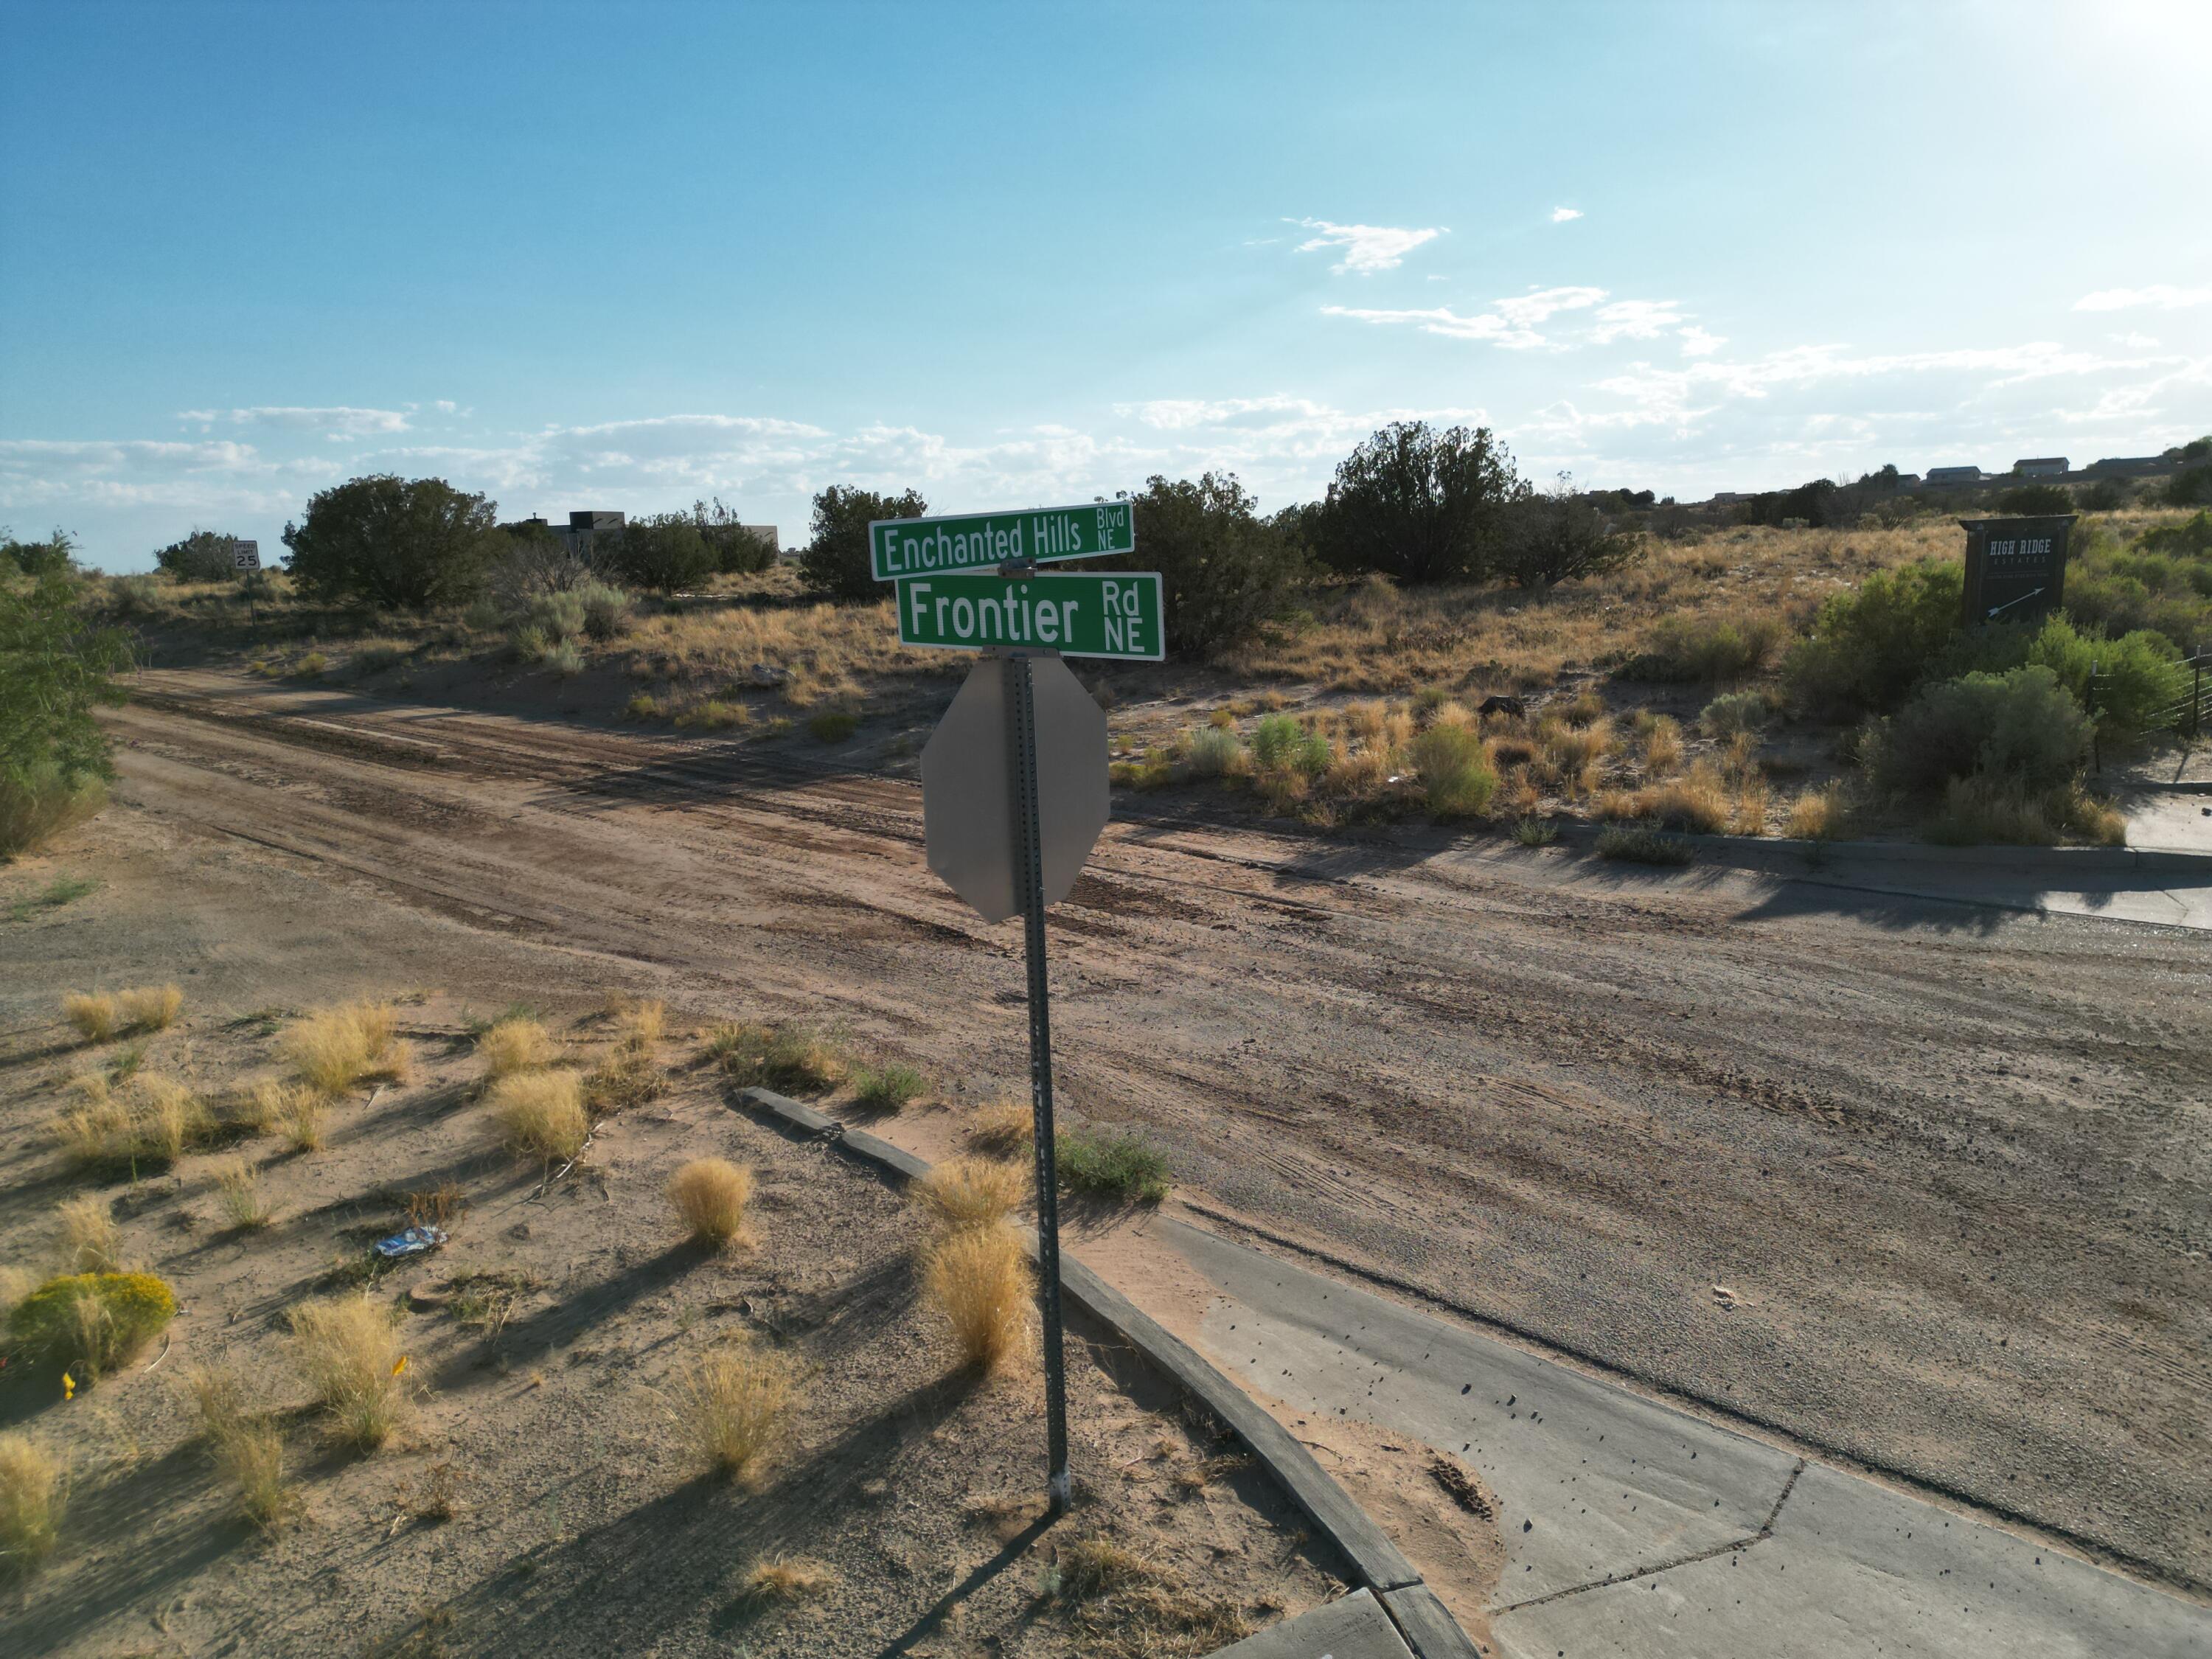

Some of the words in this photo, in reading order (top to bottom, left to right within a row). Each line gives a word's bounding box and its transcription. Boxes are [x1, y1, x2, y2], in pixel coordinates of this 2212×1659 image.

[1096, 507, 1124, 529] Blvd
[885, 518, 1023, 572] Enchanted
[1034, 515, 1081, 554] Hills
[1098, 529, 1116, 551] NE
[1989, 540, 2016, 555] HIGH
[2020, 539, 2051, 554] RIDGE
[237, 555, 257, 566] 25
[1994, 557, 2046, 565] ESTATES
[1102, 580, 1139, 616] Rd
[910, 583, 1079, 643] Frontier
[1105, 617, 1145, 653] NE
